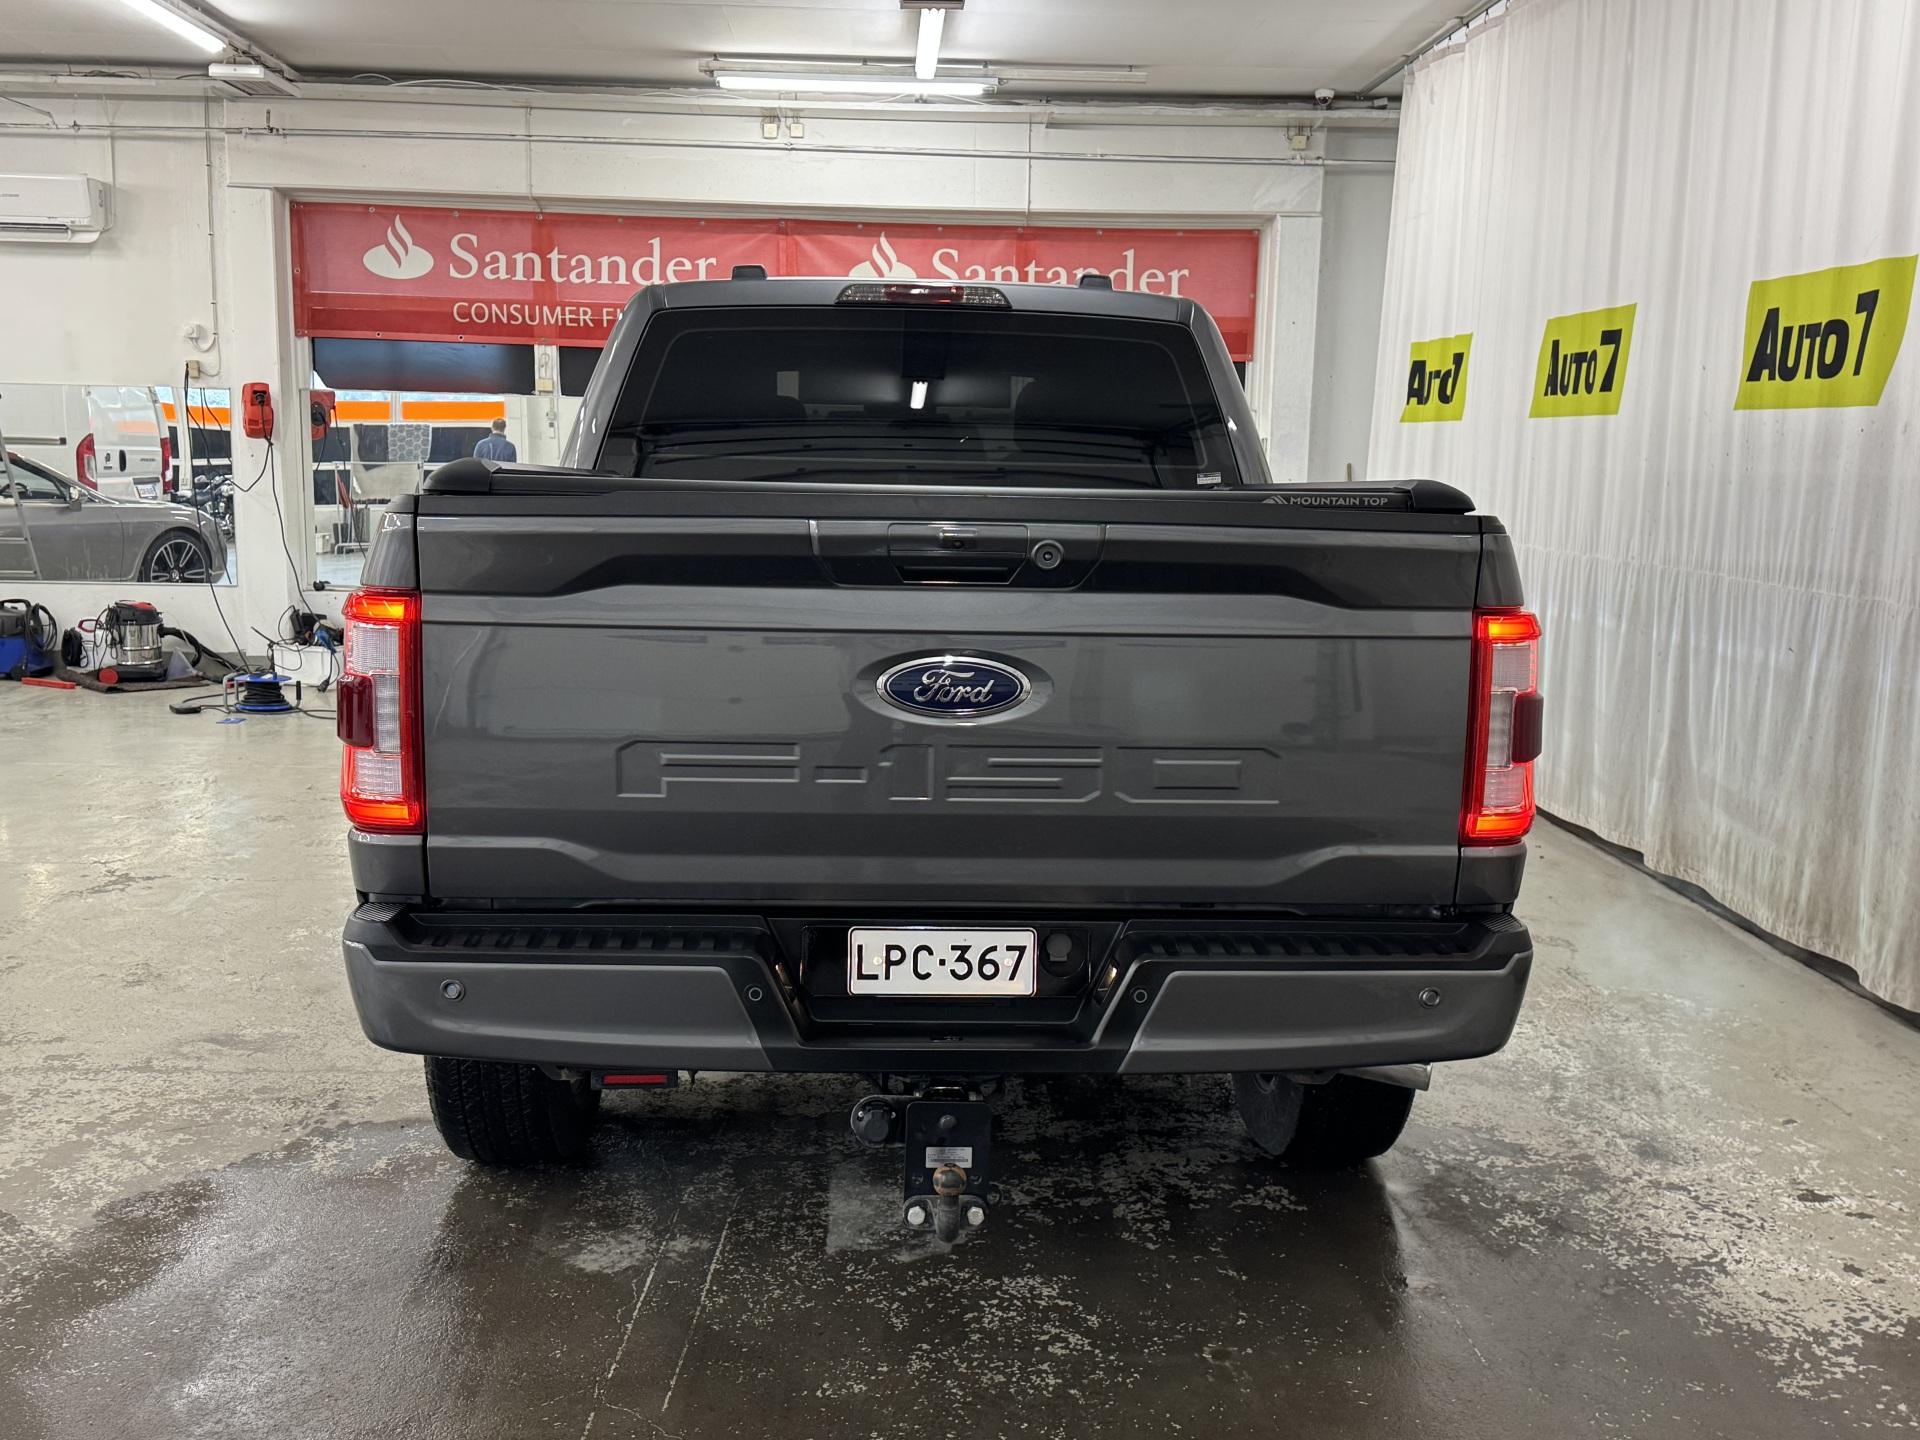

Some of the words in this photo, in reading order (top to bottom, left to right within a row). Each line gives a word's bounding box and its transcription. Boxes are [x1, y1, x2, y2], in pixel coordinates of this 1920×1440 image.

[450, 233, 717, 285] Santander
[453, 302, 594, 327] CONSUMER
[1852, 289, 1880, 376] 7
[1599, 328, 1623, 392] 7
[1289, 496, 1359, 506] MOUNTAIN
[1362, 497, 1389, 506] TOP
[913, 669, 995, 703] Ford
[617, 740, 1281, 803] F-150
